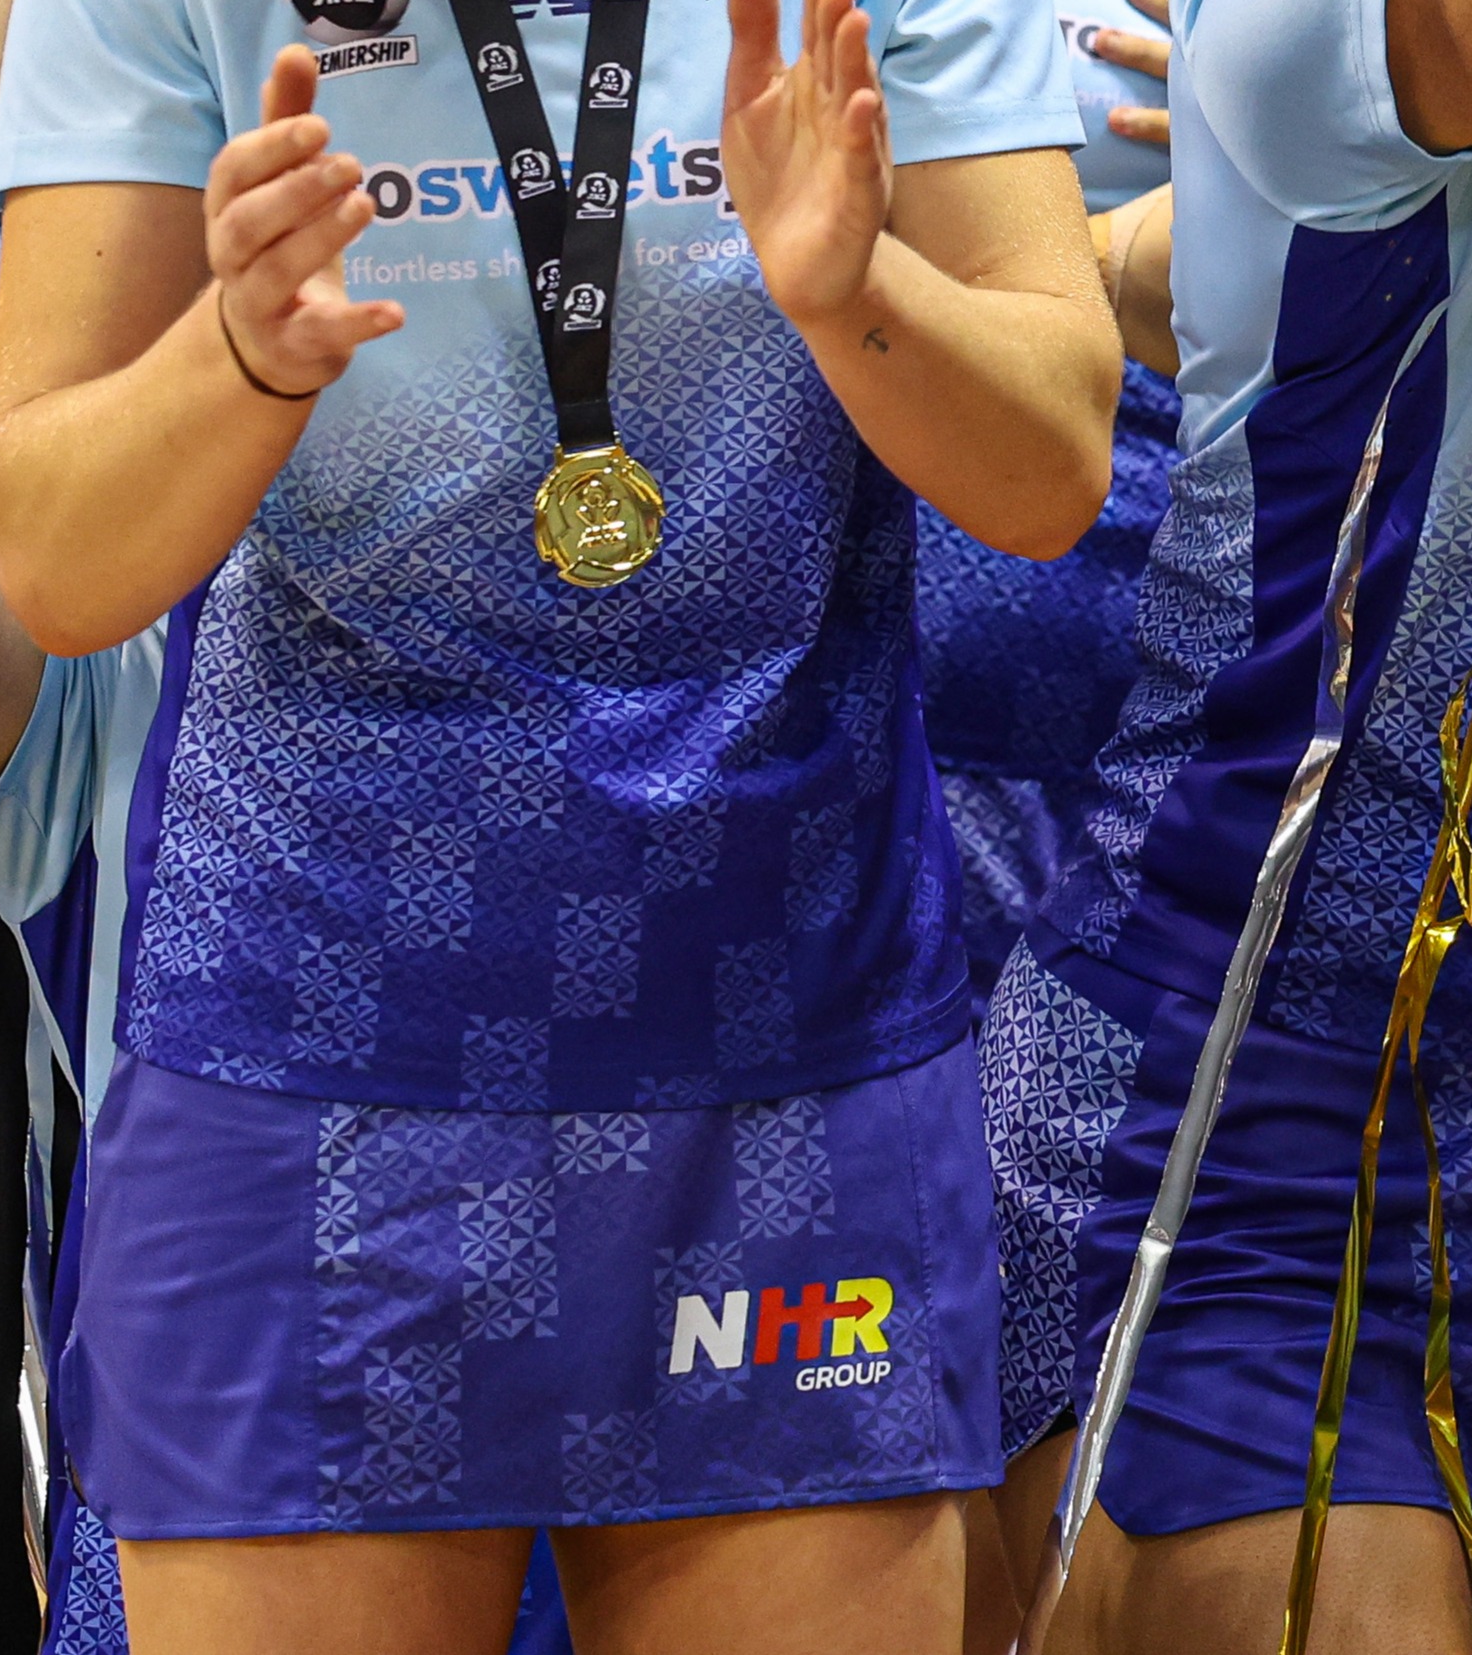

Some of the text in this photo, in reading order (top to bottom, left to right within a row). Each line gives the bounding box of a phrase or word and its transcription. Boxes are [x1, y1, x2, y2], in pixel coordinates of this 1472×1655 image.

[314, 40, 412, 76] EMIERSHIP
[634, 237, 678, 267] for
[668, 1276, 894, 1375] NHR
[795, 1360, 892, 1392] GROUP
